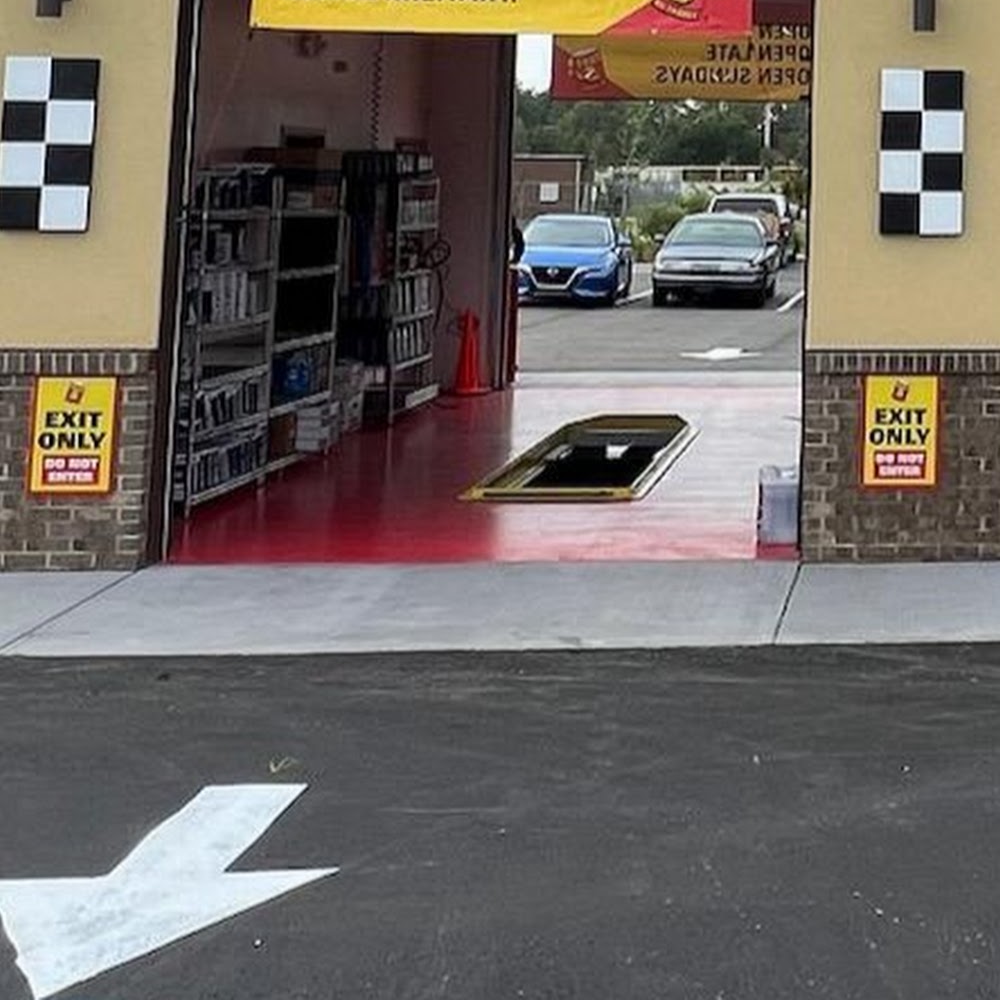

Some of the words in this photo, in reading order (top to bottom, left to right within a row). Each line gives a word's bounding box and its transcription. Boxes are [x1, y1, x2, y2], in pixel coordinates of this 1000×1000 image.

[45, 411, 103, 428] EXIT
[874, 408, 927, 425] EXIT
[38, 432, 106, 450] ONLY
[869, 428, 930, 445] ONLY
